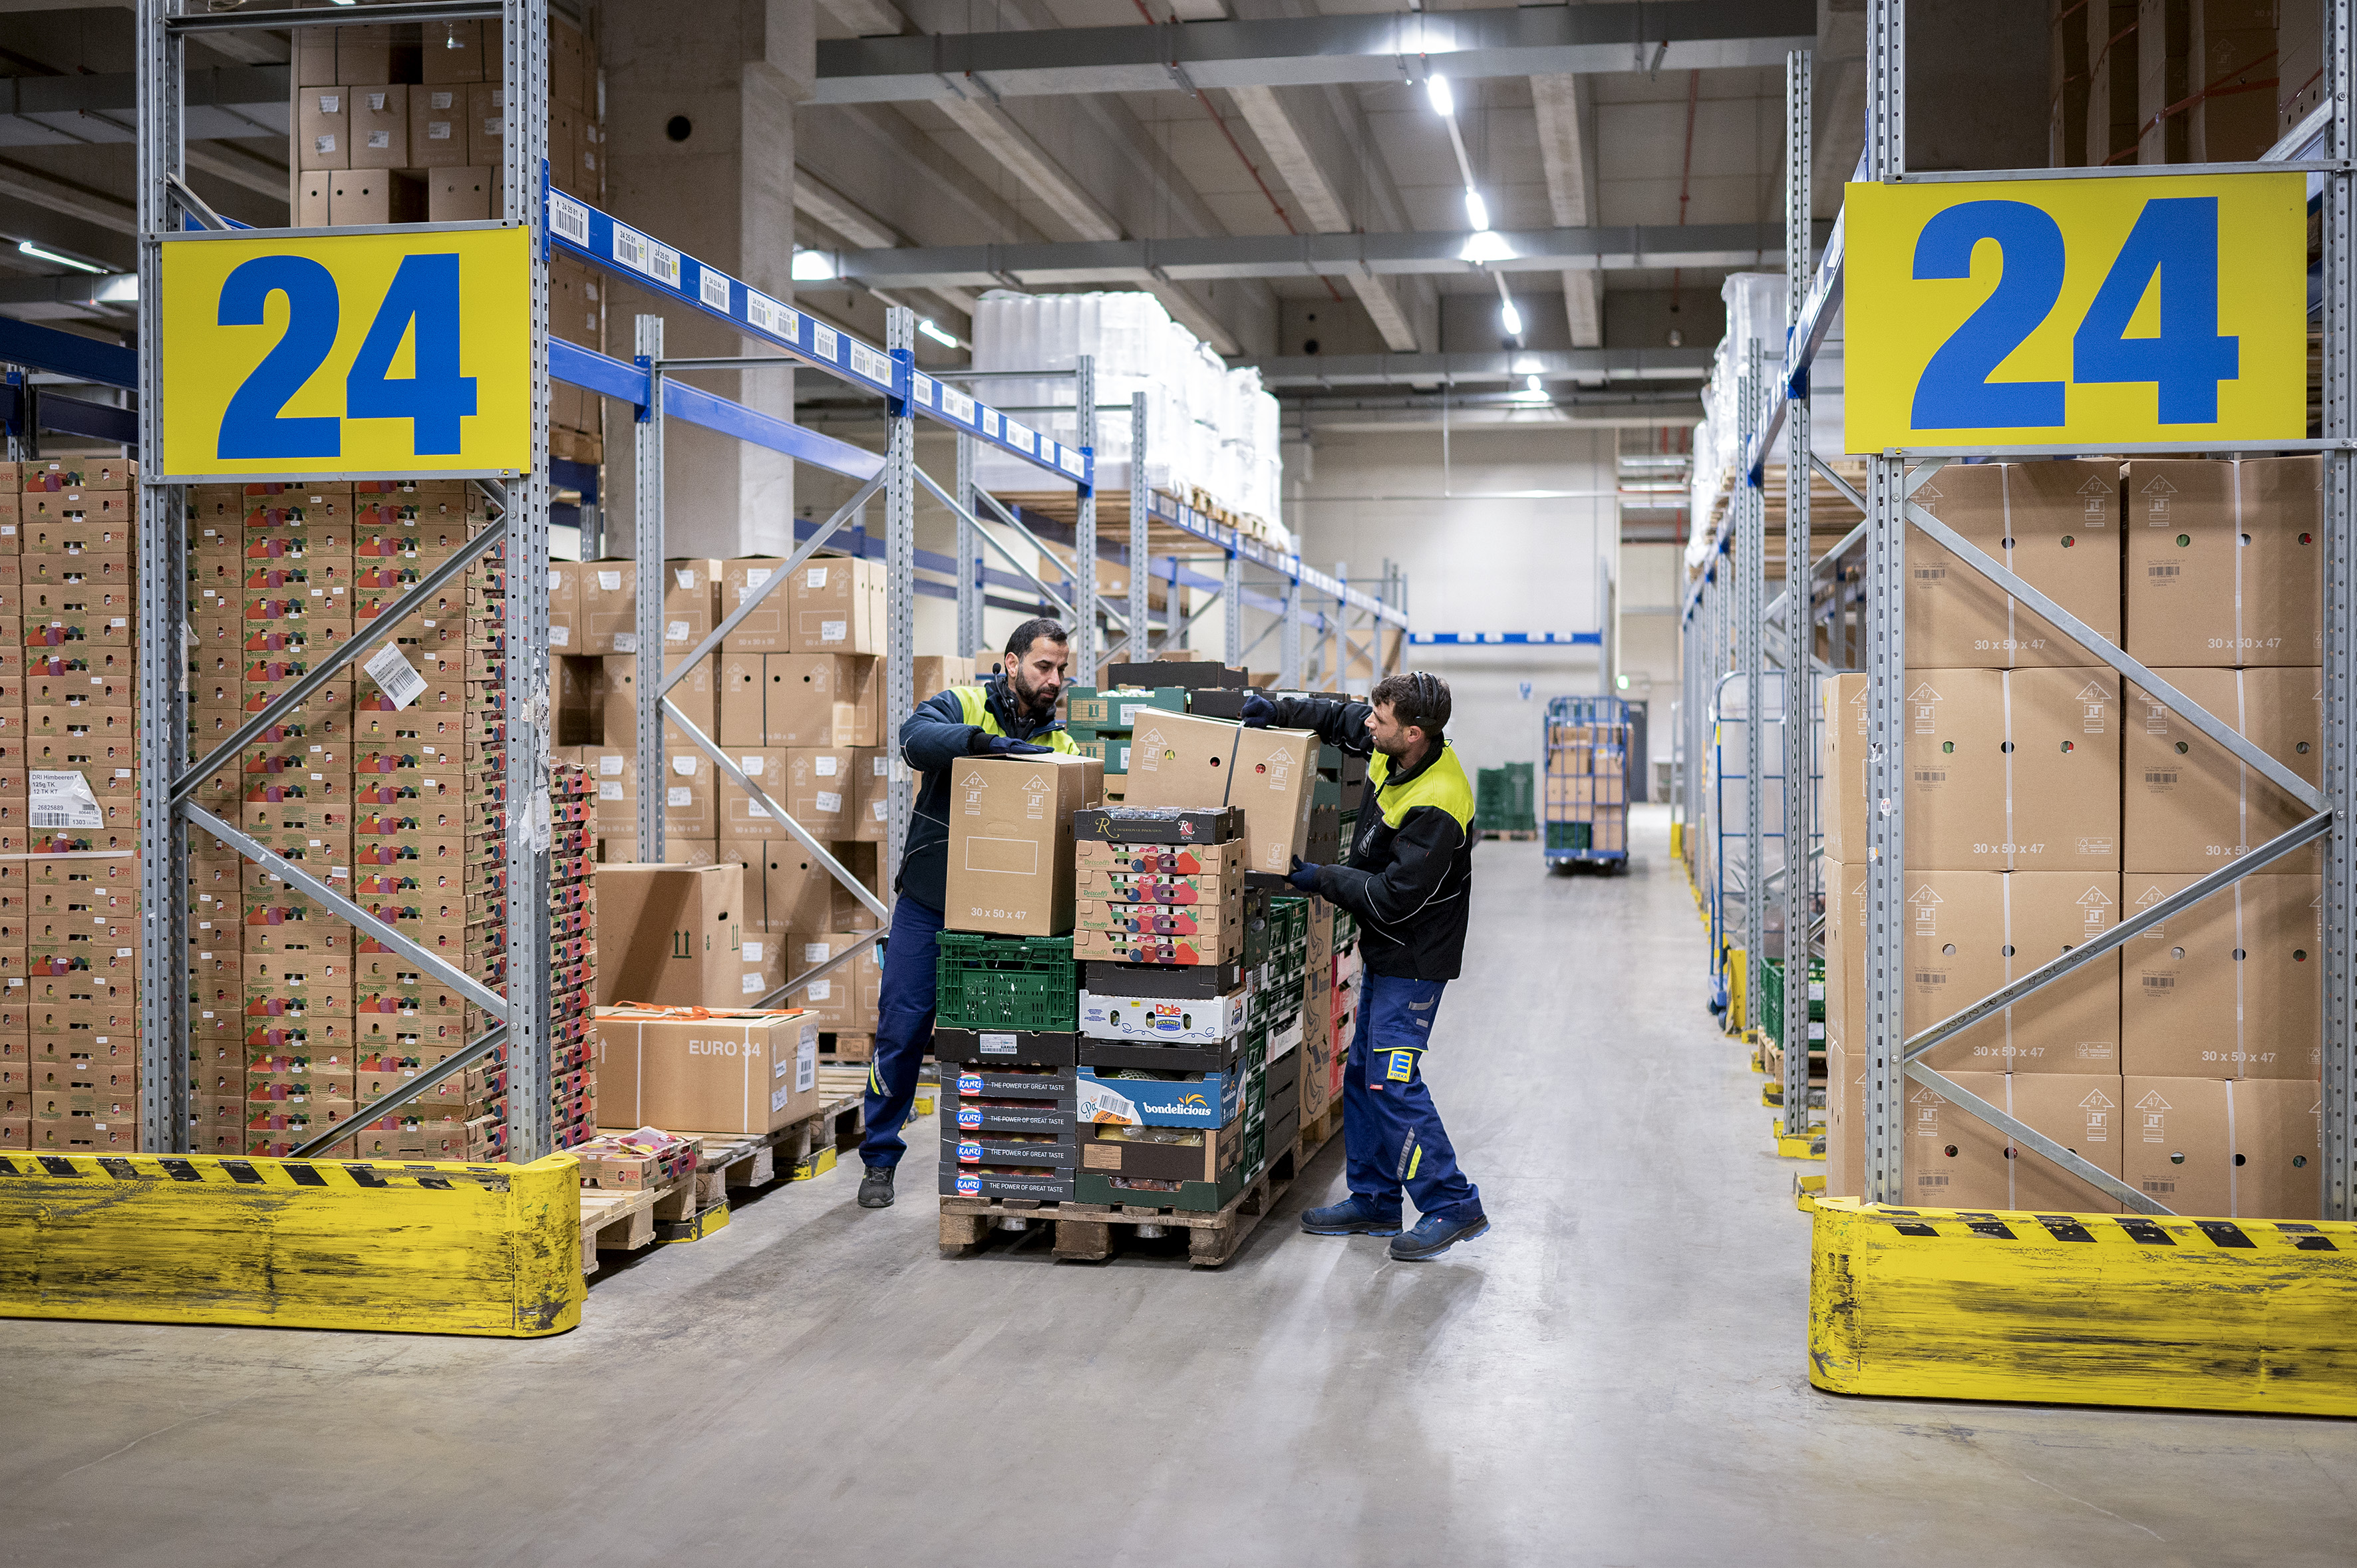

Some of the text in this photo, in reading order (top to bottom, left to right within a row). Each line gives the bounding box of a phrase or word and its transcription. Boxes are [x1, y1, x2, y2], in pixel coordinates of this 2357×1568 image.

[1911, 196, 2240, 430] 24
[218, 251, 478, 460] 24
[1919, 486, 1931, 496] 47
[2088, 481, 2101, 492] 47
[2153, 481, 2165, 491] 47
[1974, 640, 1989, 650] 30
[2002, 639, 2017, 650] 50
[2031, 639, 2046, 649] 47
[2208, 639, 2223, 649] 30
[2237, 639, 2253, 649] 50
[2265, 638, 2282, 648] 47
[1919, 689, 1931, 699] 47
[2088, 688, 2100, 698] 47
[1149, 734, 1159, 742] 39
[1095, 818, 1120, 838] R
[1178, 820, 1195, 834] R
[1973, 844, 1988, 854] 30
[2002, 844, 2016, 854] 50
[2030, 844, 2045, 854] 47
[2205, 845, 2221, 856] 30
[1919, 891, 1932, 901] 47
[2088, 892, 2101, 903] 47
[2147, 892, 2161, 903] 47
[971, 907, 983, 916] 30
[993, 909, 1005, 918] 50
[1015, 911, 1026, 919] 47
[1156, 1004, 1181, 1017] Dole
[689, 1039, 762, 1058] EURO 34
[1973, 1046, 1989, 1057] 30
[2002, 1046, 2018, 1057] 50
[2030, 1046, 2045, 1057] 47
[2202, 1051, 2218, 1062] 30
[2231, 1052, 2247, 1062] 50
[2259, 1052, 2277, 1063] 47
[2090, 1095, 2103, 1106] 47
[2147, 1097, 2160, 1107] 47
[1143, 1102, 1211, 1116] bondelicious
